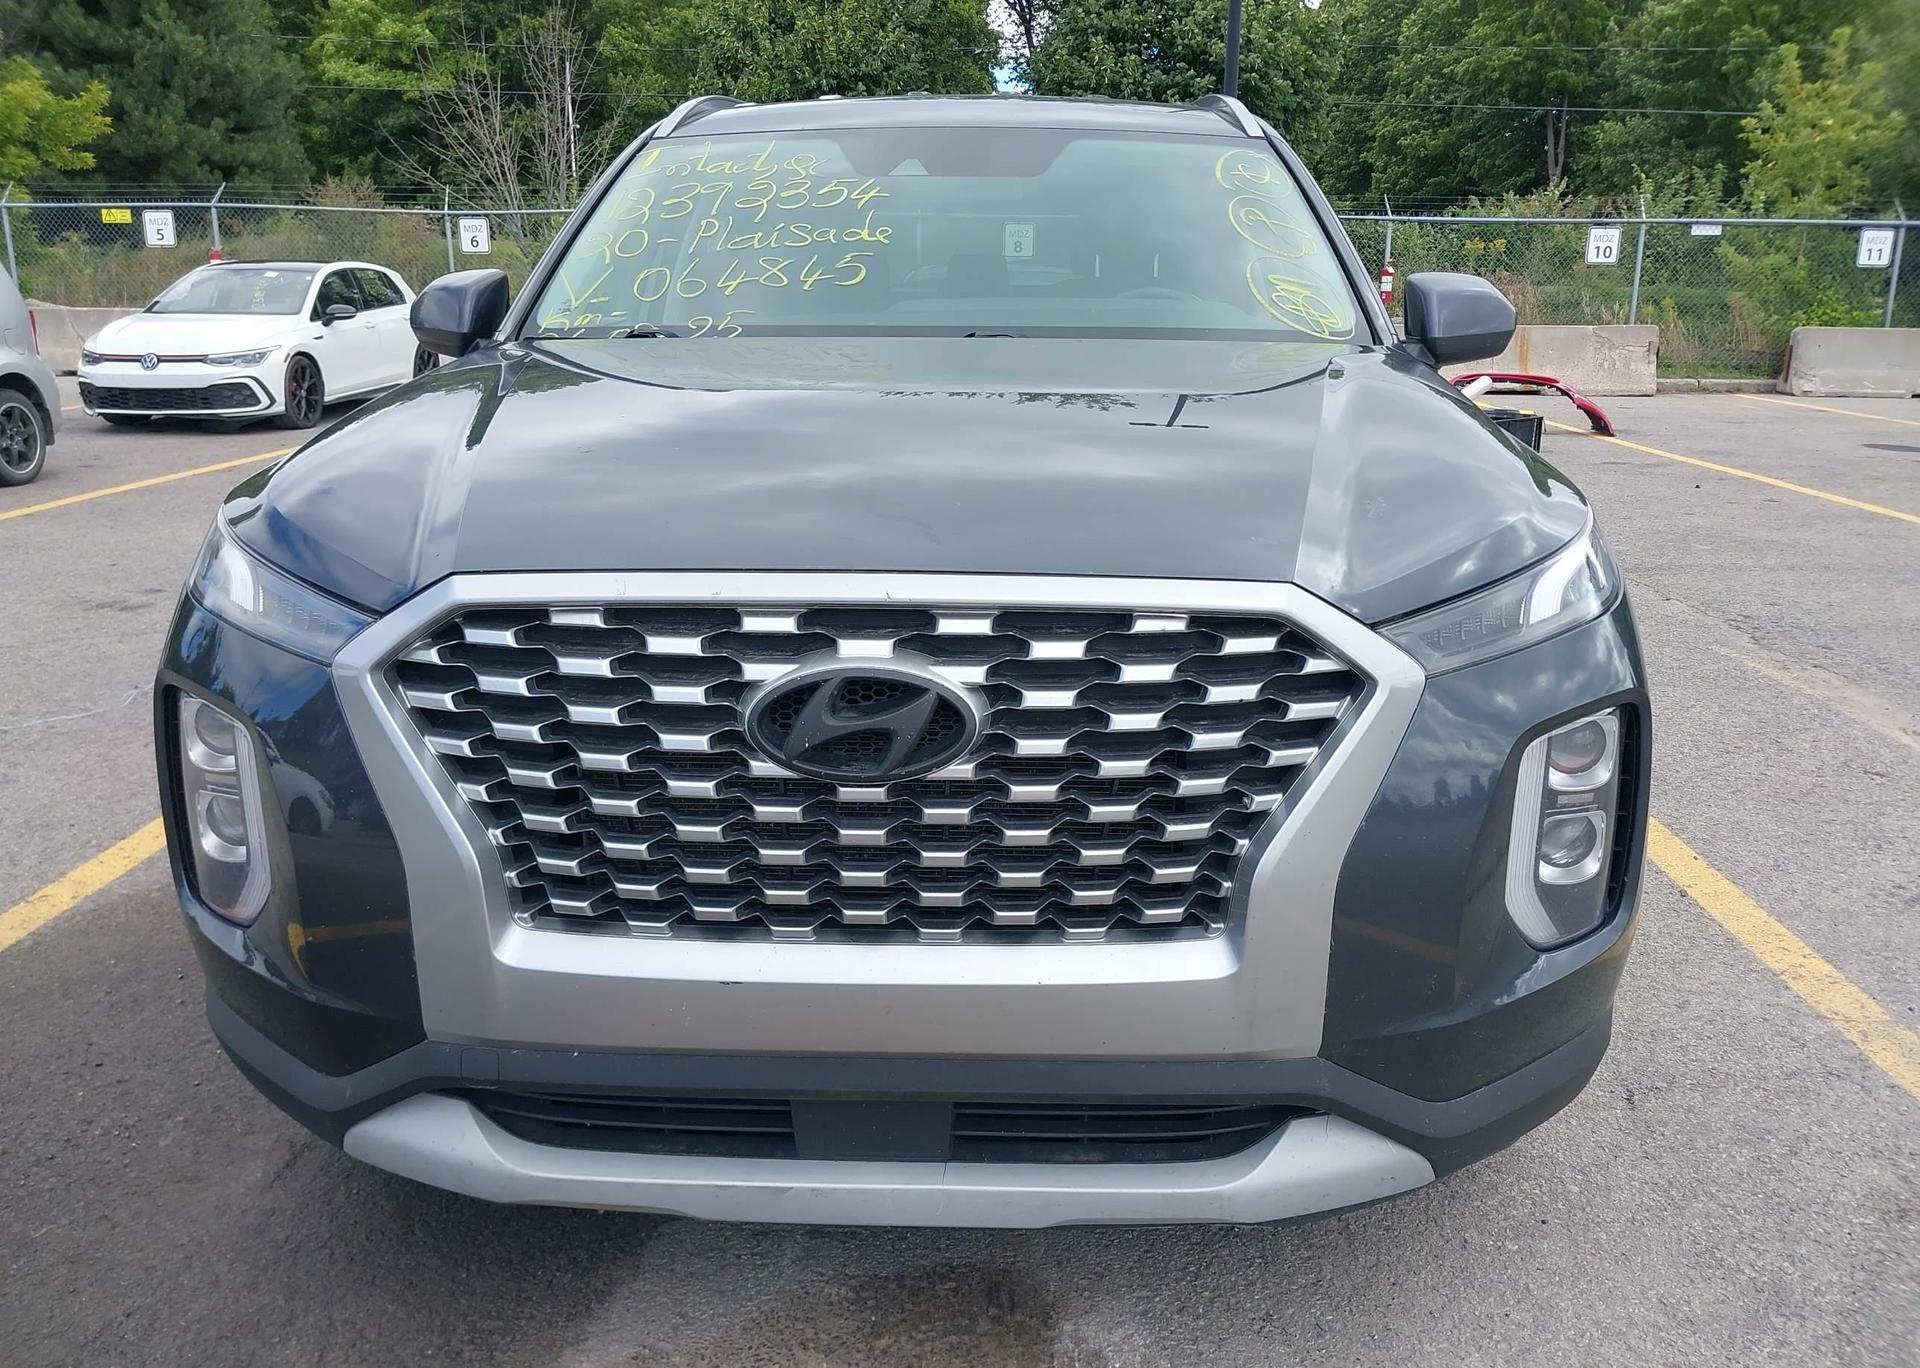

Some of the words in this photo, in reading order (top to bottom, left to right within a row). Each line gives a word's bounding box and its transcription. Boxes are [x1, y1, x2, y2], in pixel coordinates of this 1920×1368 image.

[148, 217, 169, 227] MDZ
[463, 224, 484, 233] MDZ
[156, 228, 165, 241] 5
[1008, 229, 1030, 240] MDZ
[1593, 234, 1616, 243] MDZ
[470, 235, 479, 248] 6
[1013, 240, 1023, 253] 8
[1594, 245, 1613, 259] 10
[1866, 248, 1883, 261] 11
[633, 252, 875, 301] 064845
